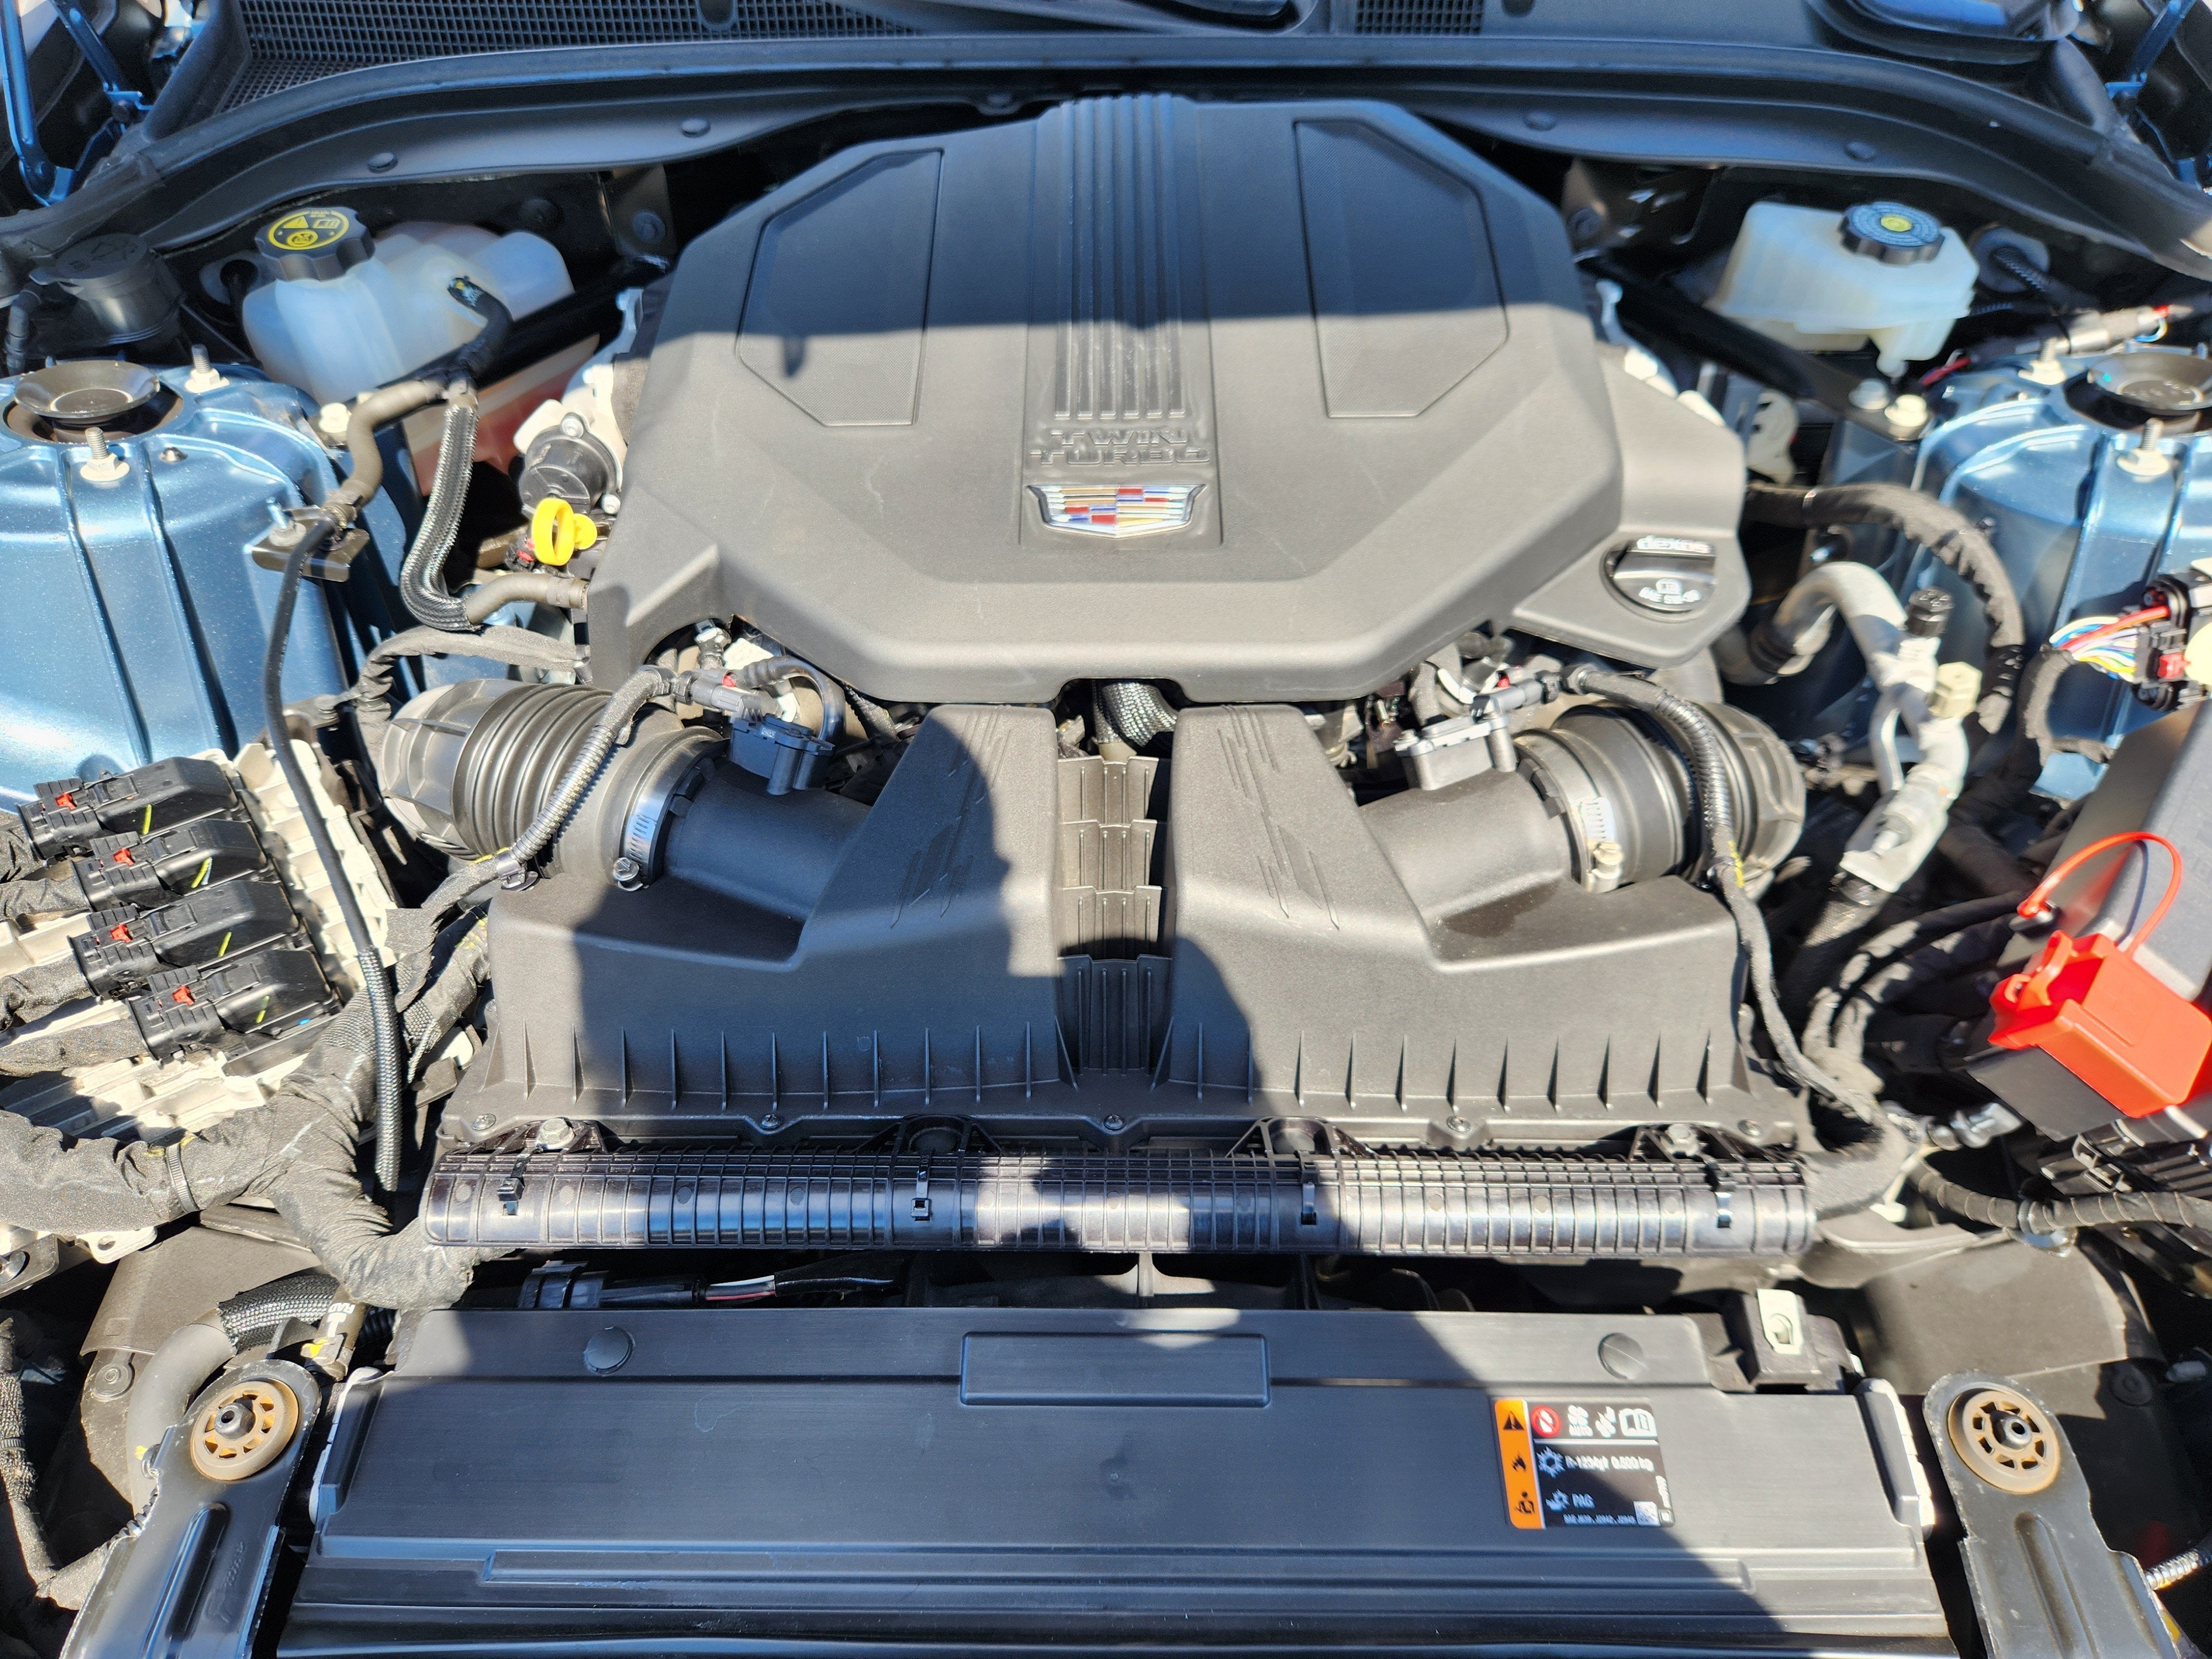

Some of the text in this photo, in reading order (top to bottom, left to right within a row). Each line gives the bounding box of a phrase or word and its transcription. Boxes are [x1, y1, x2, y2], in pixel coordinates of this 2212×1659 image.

[1050, 428, 1188, 446] TWIN
[1030, 447, 1211, 467] TURBO
[1636, 535, 1712, 554] dexos
[327, 1302, 356, 1314] RAD
